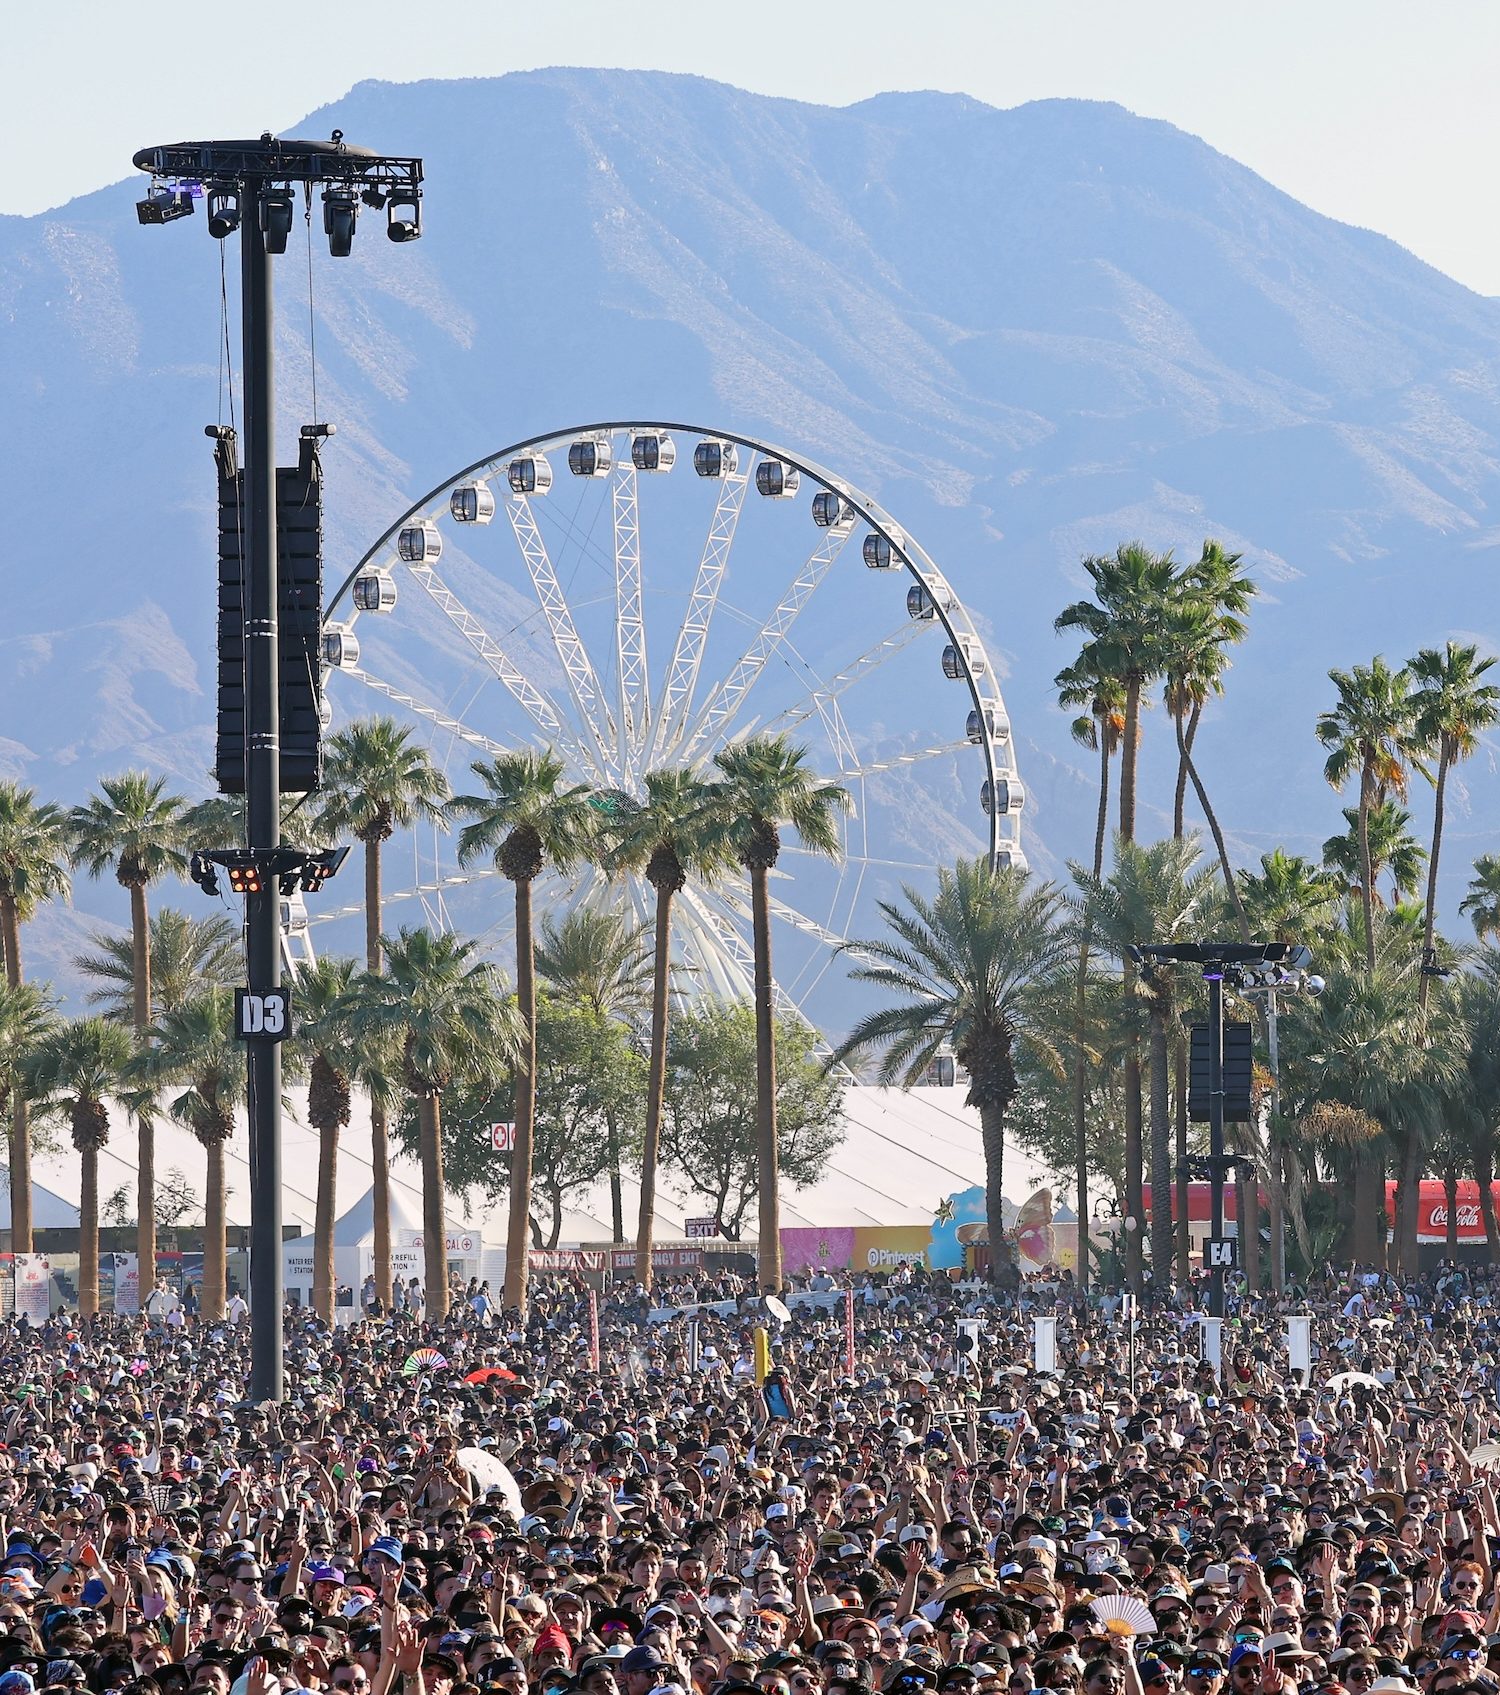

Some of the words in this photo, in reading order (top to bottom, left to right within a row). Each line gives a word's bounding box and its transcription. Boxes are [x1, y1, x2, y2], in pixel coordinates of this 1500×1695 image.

[242, 995, 284, 1033] D3
[1429, 1205, 1481, 1227] CocCola
[687, 1225, 717, 1236] EXIT
[615, 1253, 675, 1266] EMEENCY
[679, 1252, 700, 1265] EXIT
[880, 1250, 924, 1265] Pinterest
[1210, 1242, 1232, 1265] E4
